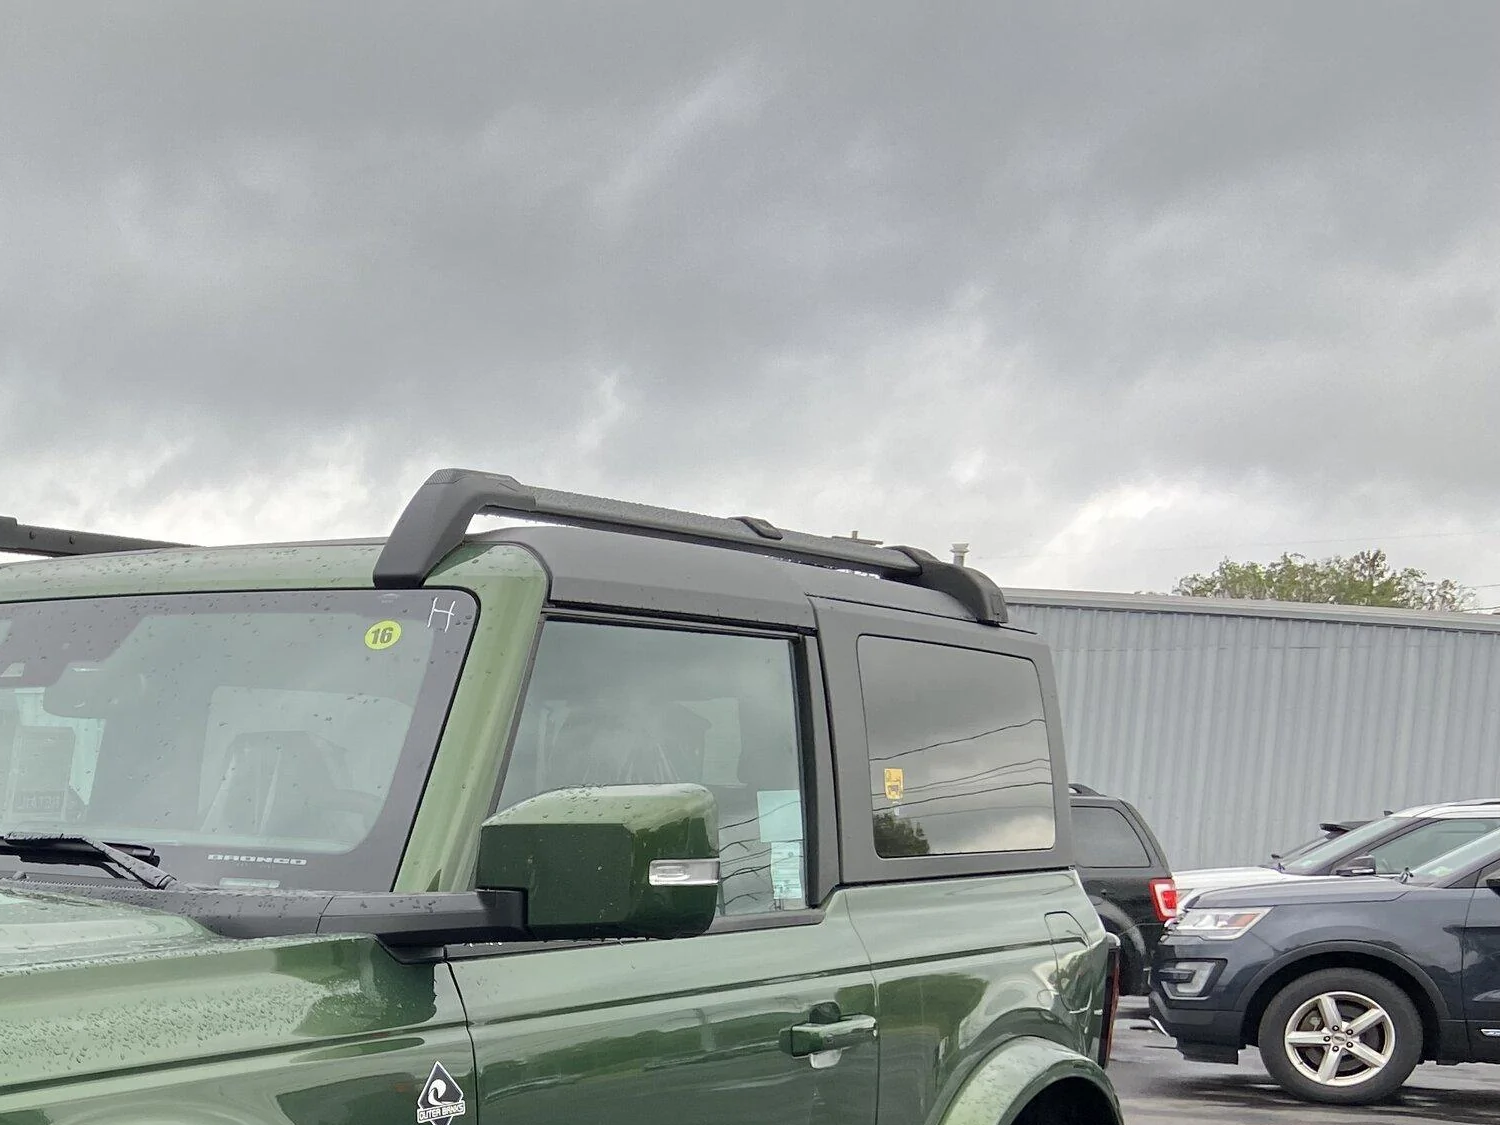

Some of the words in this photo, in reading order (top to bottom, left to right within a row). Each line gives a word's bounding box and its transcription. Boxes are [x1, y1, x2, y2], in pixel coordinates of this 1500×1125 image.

[427, 597, 456, 633] H
[371, 627, 394, 645] 16
[207, 854, 308, 866] BRONCO
[419, 1108, 442, 1121] OUTER
[442, 1104, 464, 1116] BANKS
